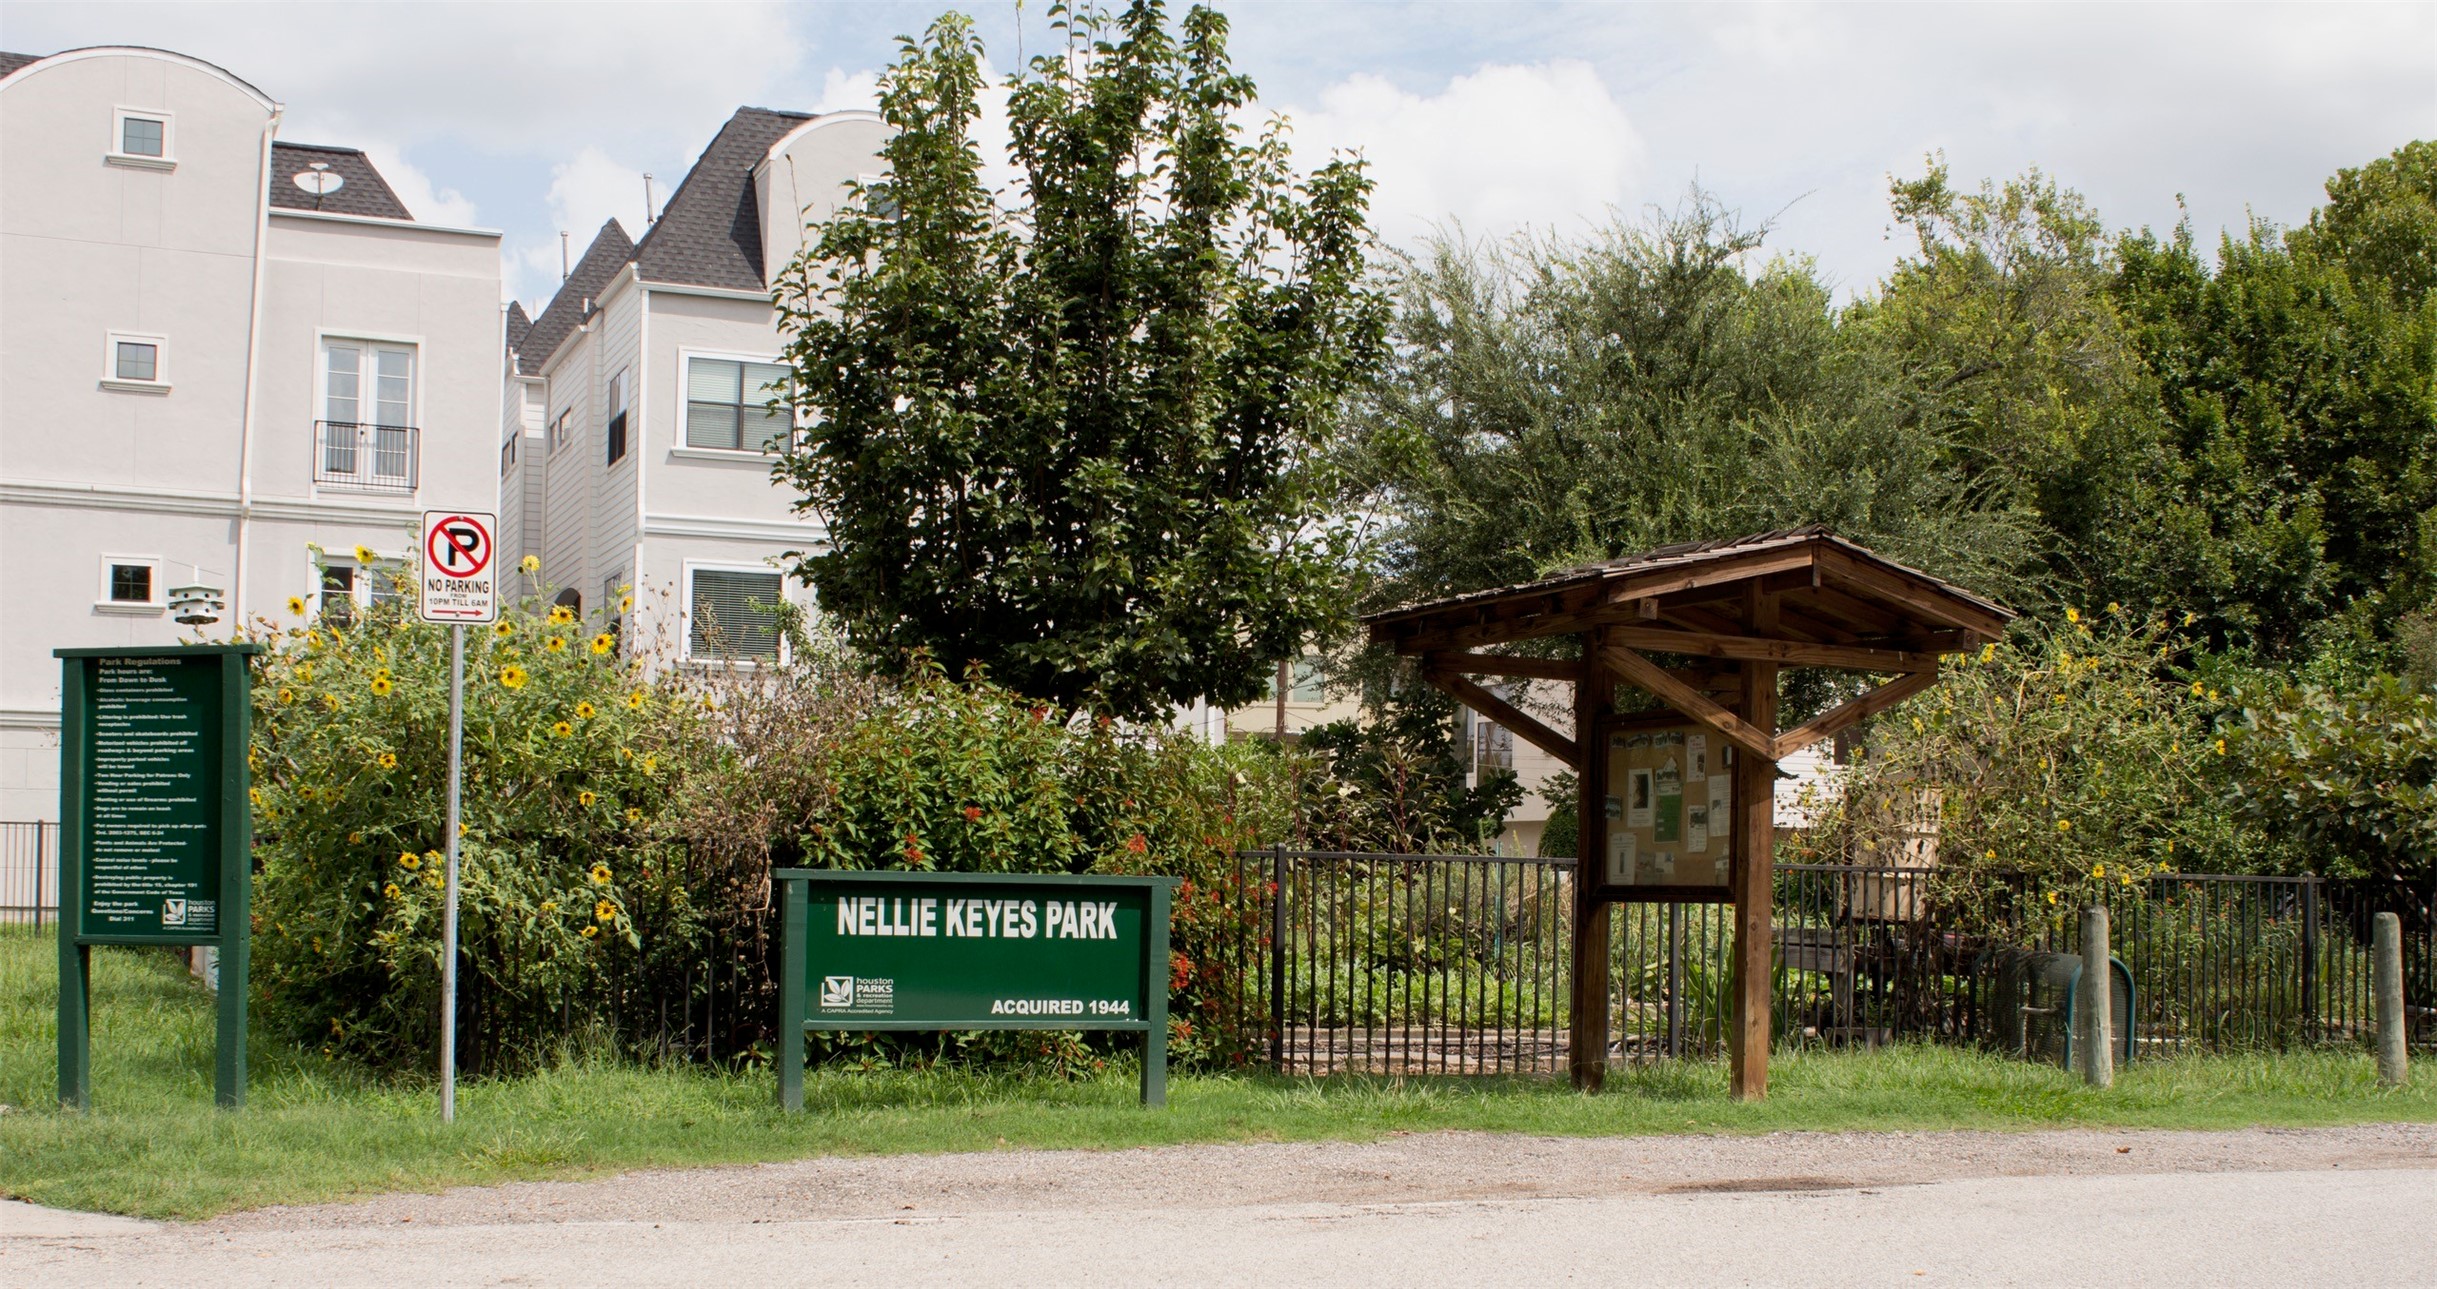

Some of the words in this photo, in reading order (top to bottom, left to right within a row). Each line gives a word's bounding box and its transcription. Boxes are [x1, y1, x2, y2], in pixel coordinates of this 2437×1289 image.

[428, 579, 442, 591] NO
[446, 580, 489, 594] PARKING
[124, 658, 181, 666] Regulations
[838, 896, 937, 936] NELLIE
[946, 899, 1036, 939] KEYES
[1046, 901, 1118, 940] PARK
[991, 1000, 1084, 1016] ACQUIRED
[1089, 1000, 1130, 1014] 1944
